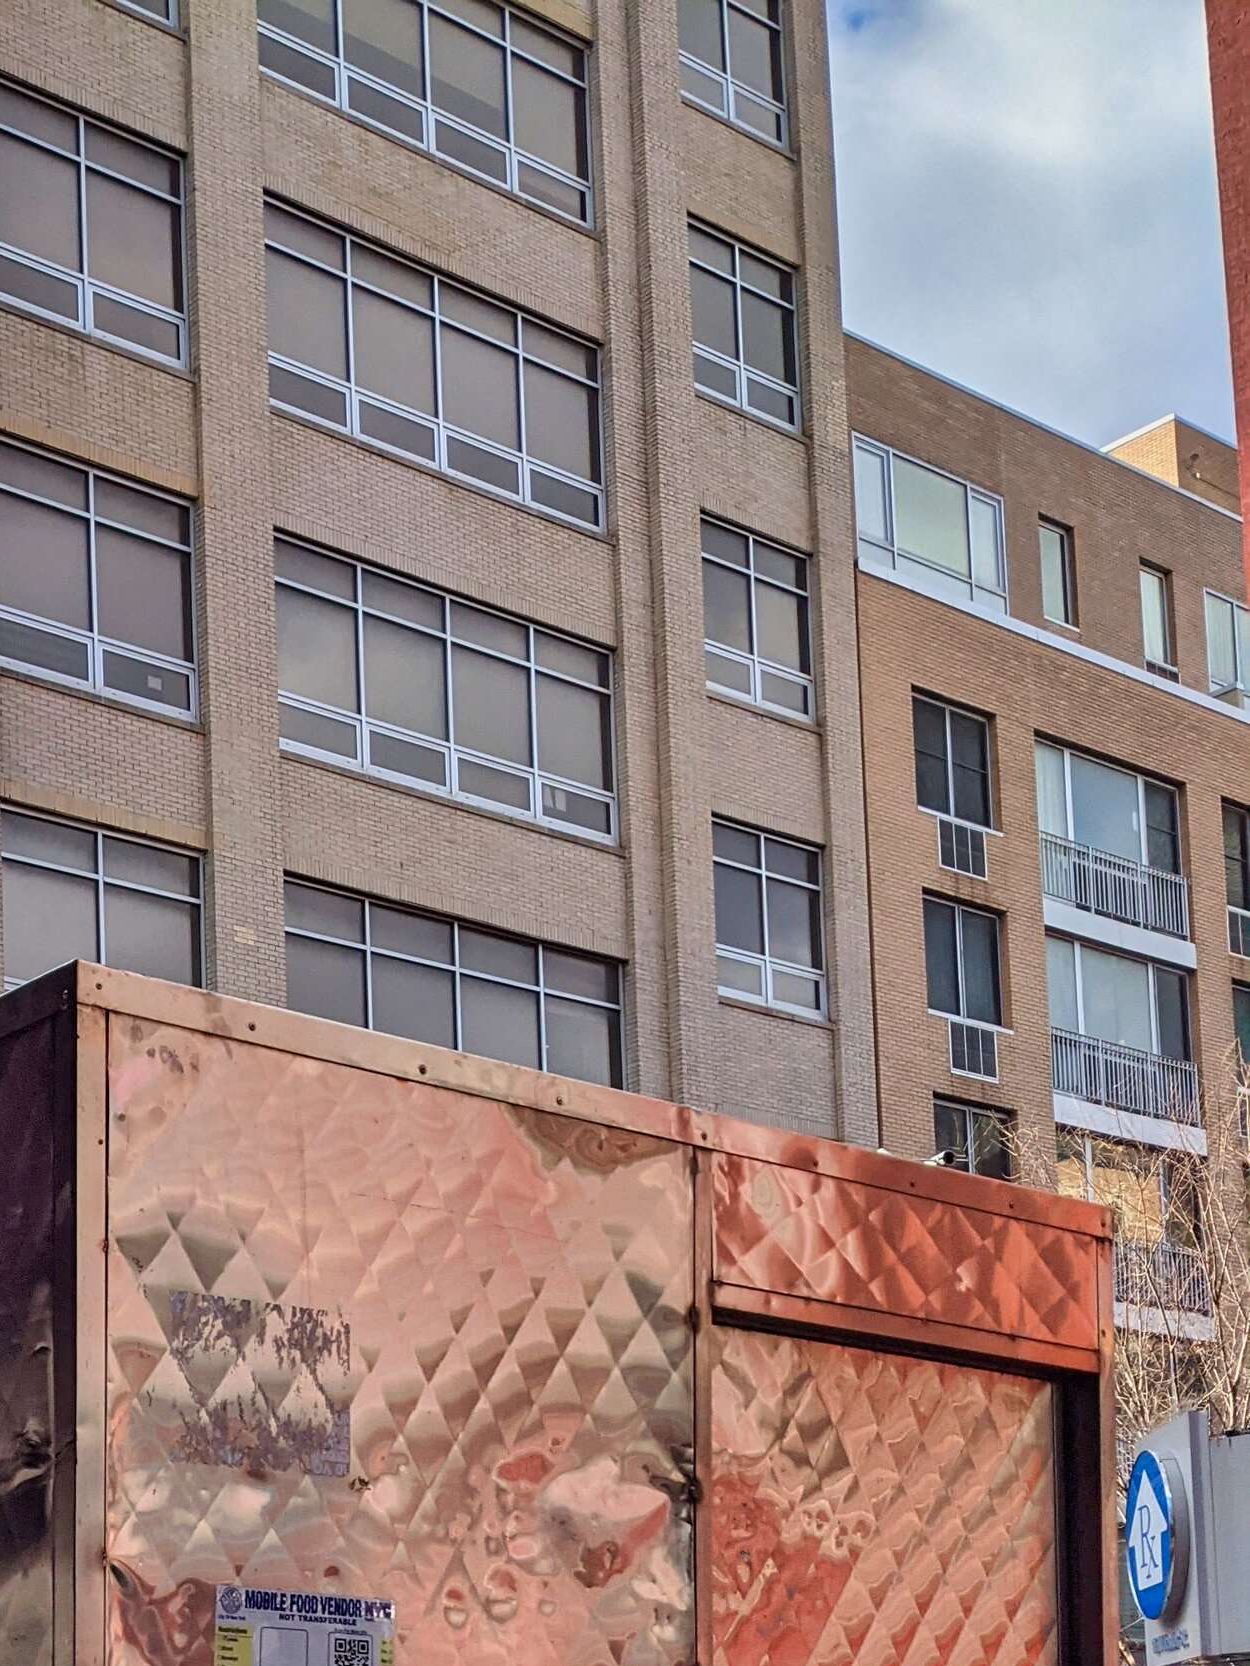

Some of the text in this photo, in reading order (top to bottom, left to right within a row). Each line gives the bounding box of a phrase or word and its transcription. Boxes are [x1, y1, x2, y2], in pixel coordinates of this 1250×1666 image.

[245, 1590, 395, 1619] MOBILE FOOD VENDOR NYC
[279, 1613, 358, 1627] NOT TRANSFERABLE
